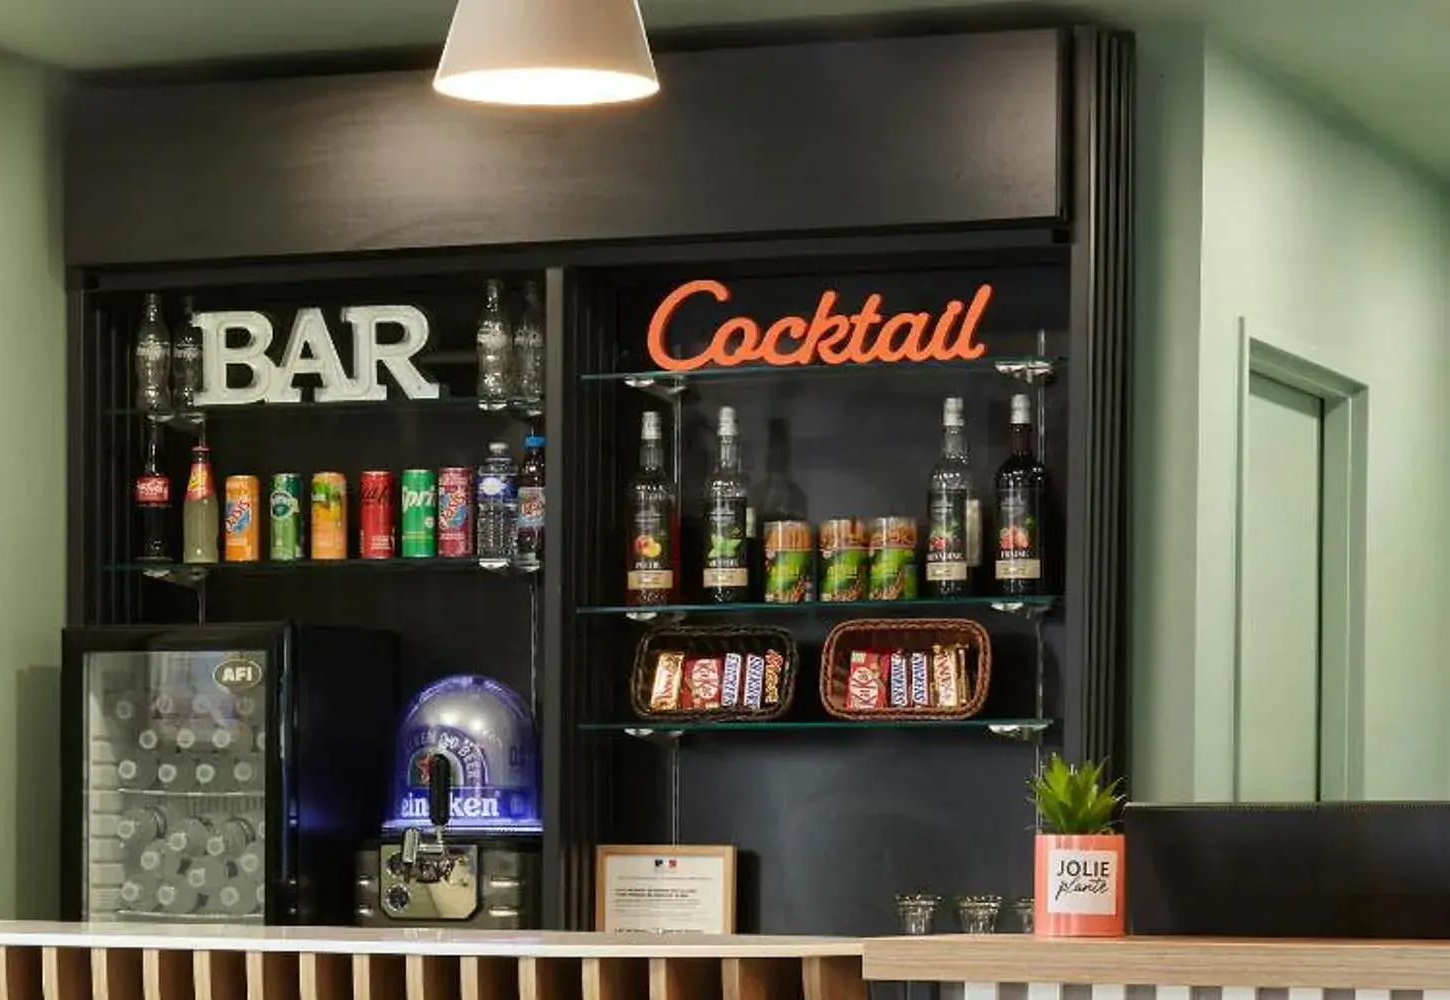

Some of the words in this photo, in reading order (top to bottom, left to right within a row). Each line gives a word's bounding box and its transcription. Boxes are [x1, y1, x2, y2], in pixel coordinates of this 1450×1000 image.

[647, 279, 994, 371] Cocktail
[191, 304, 439, 405] BAR
[221, 665, 253, 682] AFI
[401, 791, 500, 817] einken
[1057, 860, 1110, 877] JOLIE
[1055, 876, 1109, 901] plante
